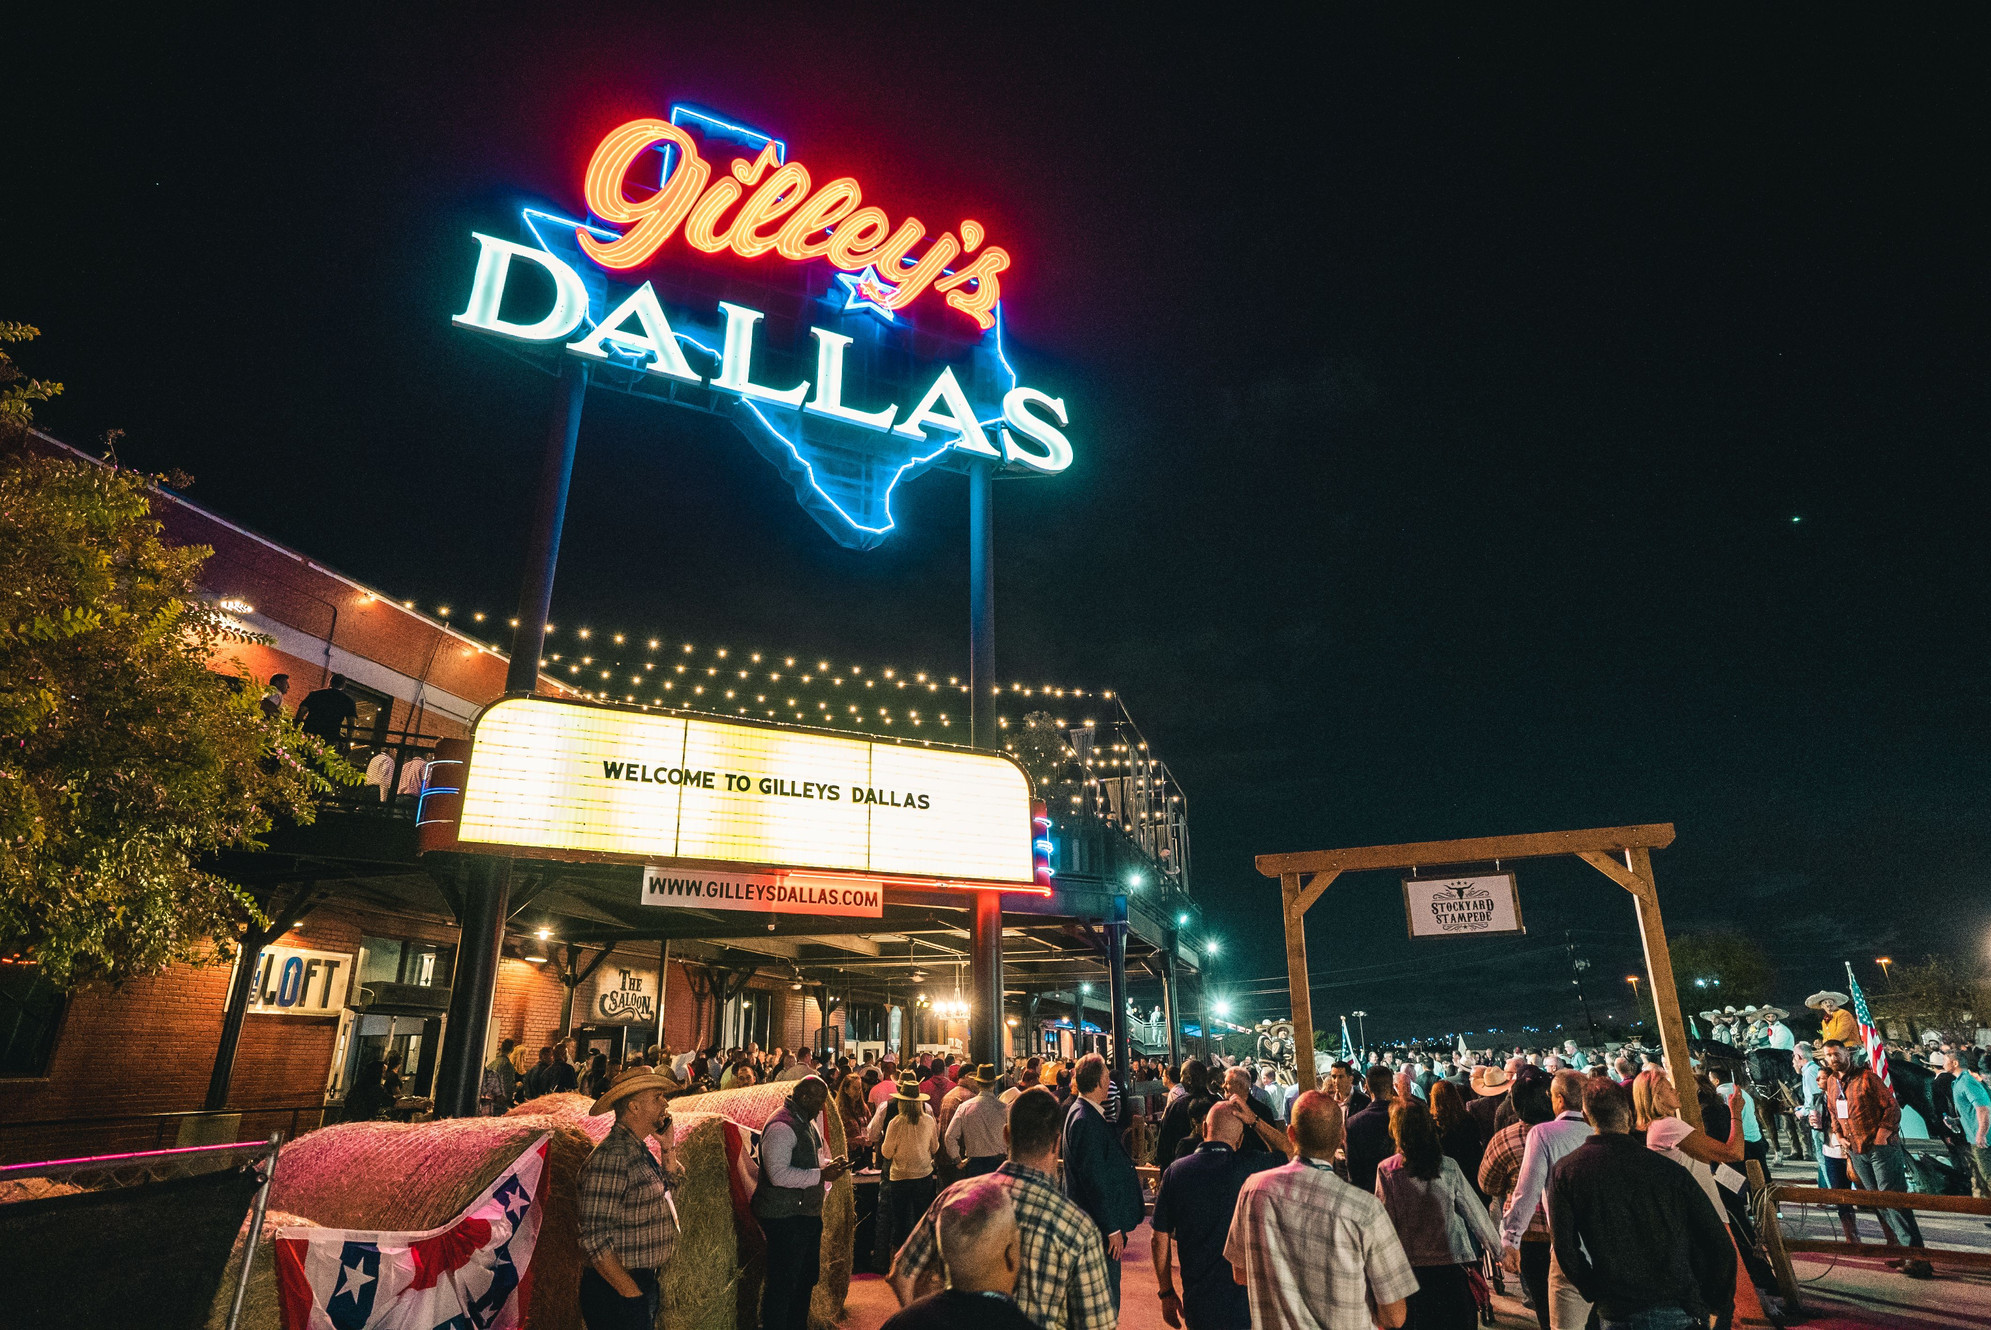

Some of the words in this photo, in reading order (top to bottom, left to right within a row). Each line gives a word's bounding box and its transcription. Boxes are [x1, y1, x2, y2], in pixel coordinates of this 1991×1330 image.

[575, 118, 1011, 330] Gilley's
[451, 231, 1075, 475] DALLAS
[603, 760, 716, 790] WELCOME
[725, 773, 751, 792] TO
[758, 778, 841, 801] GILLEYS
[852, 787, 931, 810] DALLAS
[649, 876, 878, 907] WWW.GILLEYSDALLAS.COM
[1431, 899, 1494, 914] STOCKYARD
[1436, 912, 1492, 924] STAMPEDE
[260, 953, 340, 1008] LOFT
